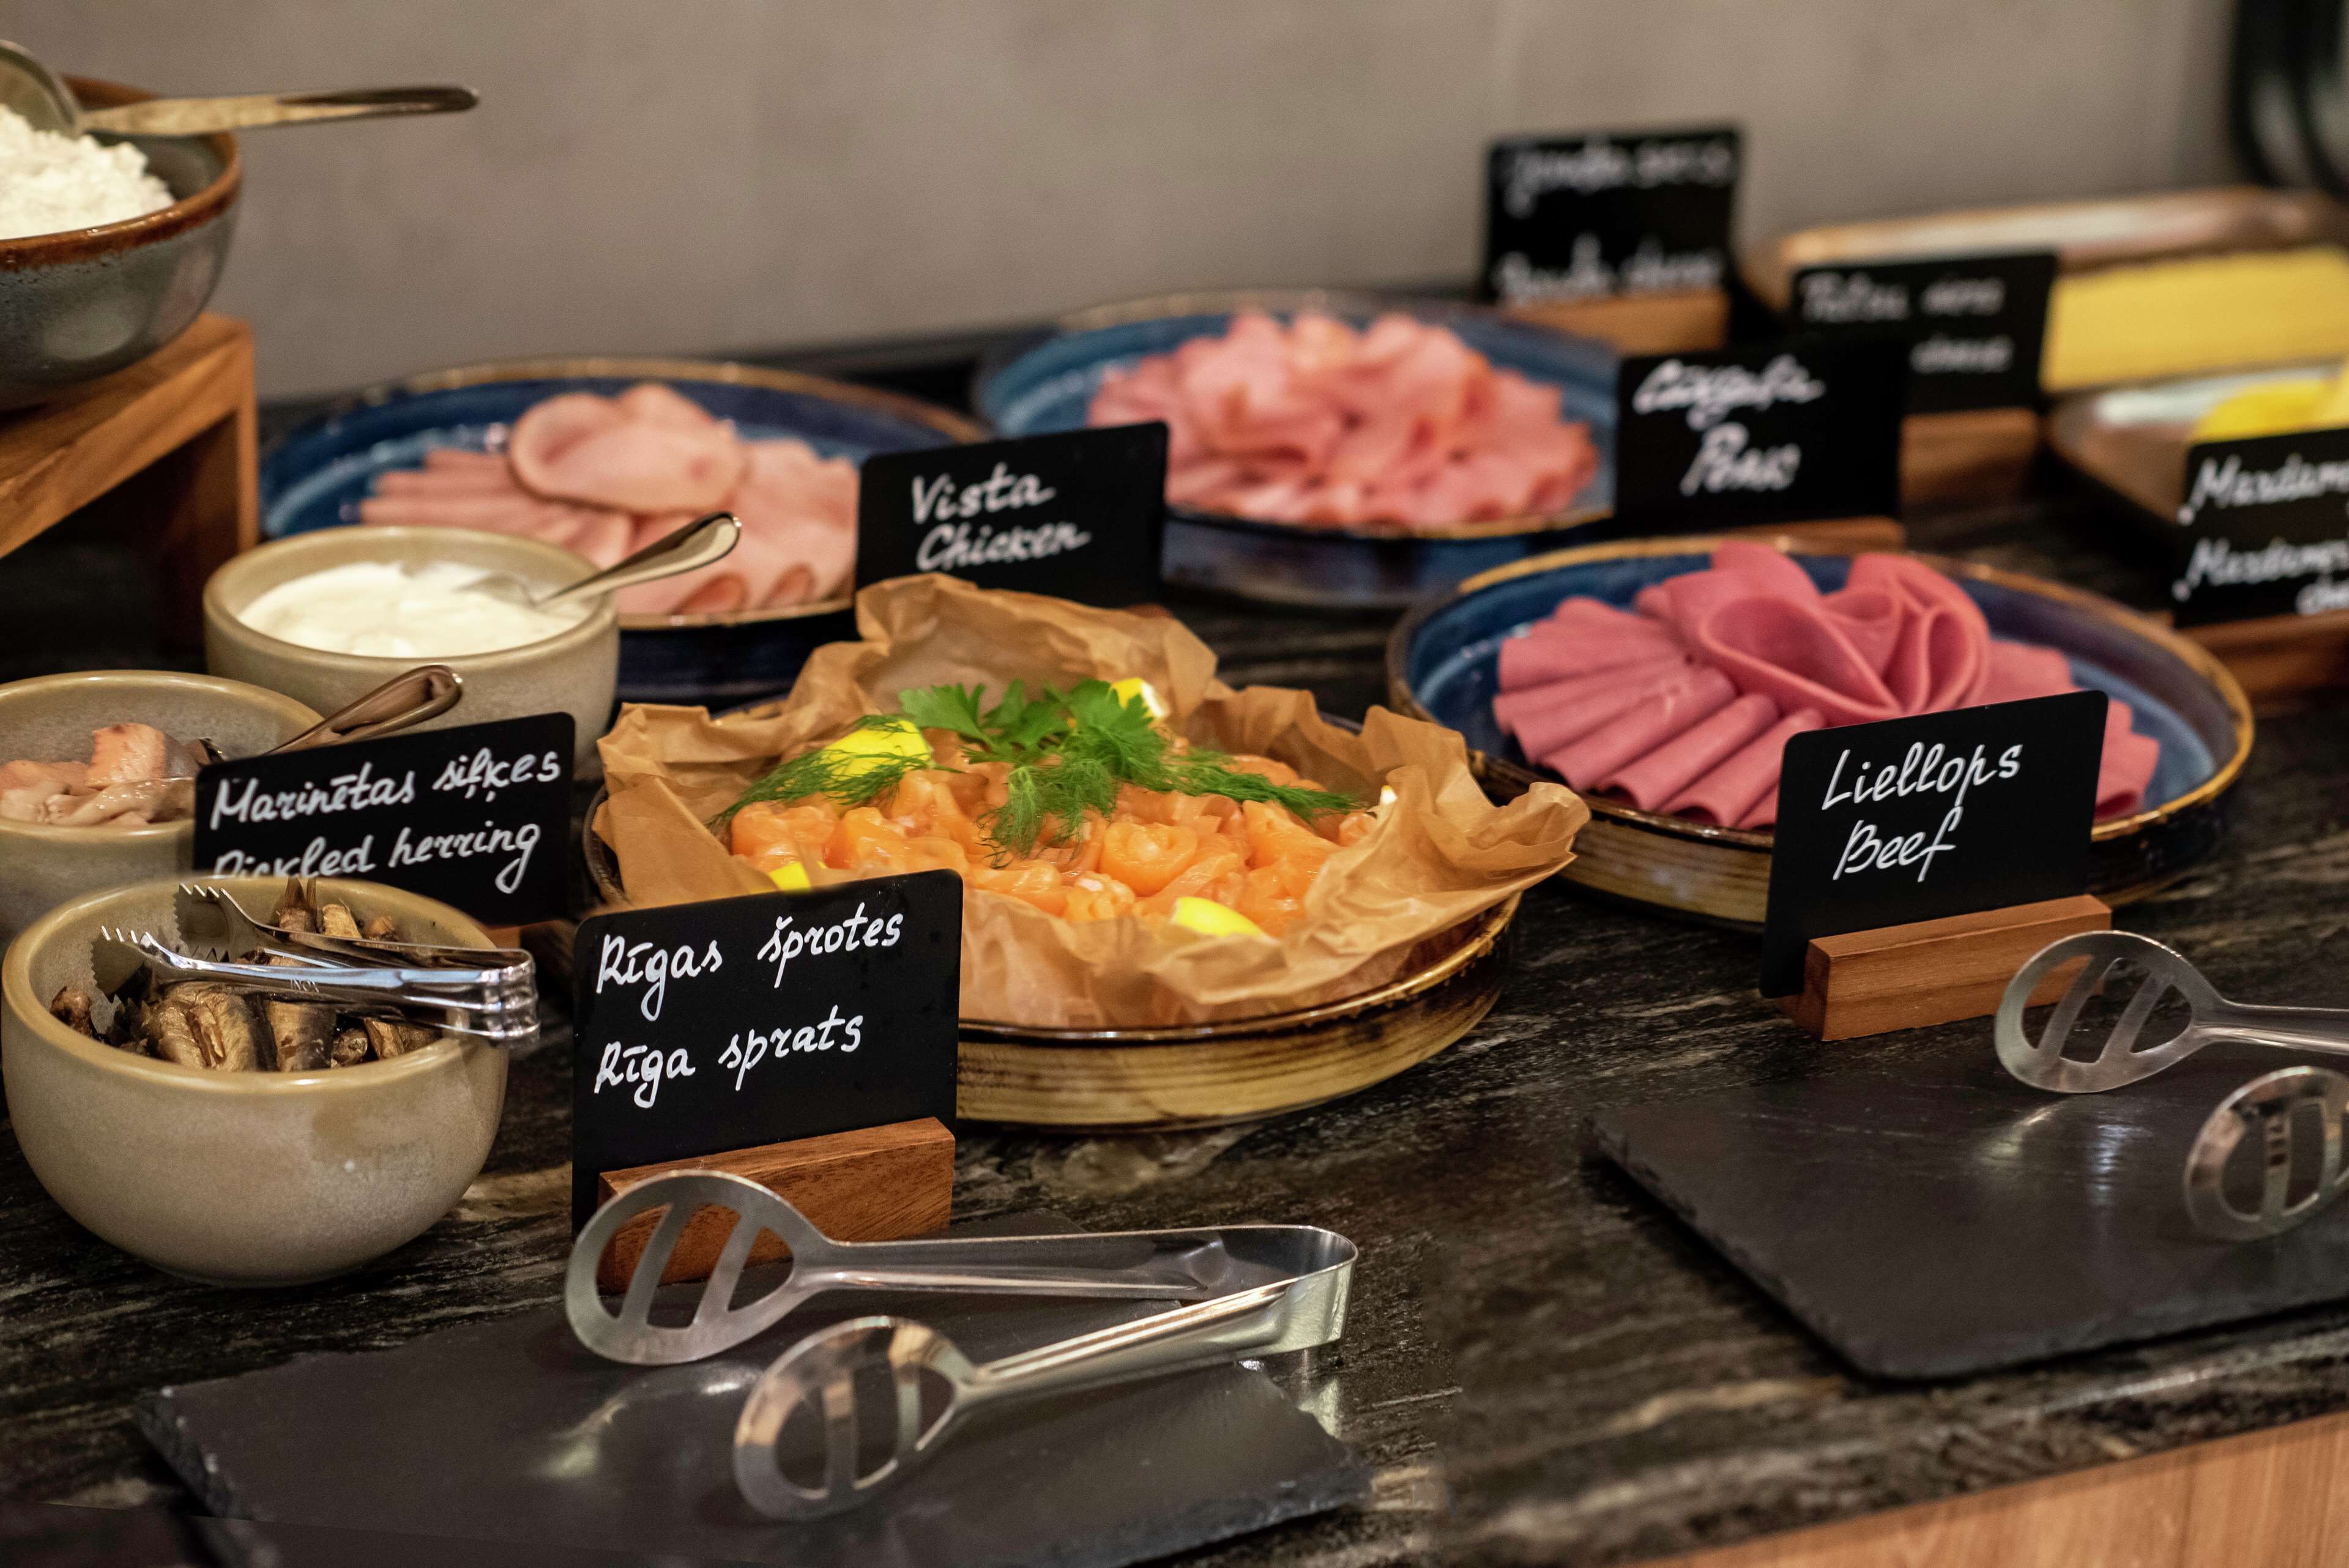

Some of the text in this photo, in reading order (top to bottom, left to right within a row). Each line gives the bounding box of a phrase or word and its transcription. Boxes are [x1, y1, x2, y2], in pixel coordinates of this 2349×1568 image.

[911, 461, 1057, 524] Vista
[916, 522, 1092, 571] Chicken
[210, 762, 415, 831] Marinētas
[1821, 741, 2023, 810] Liellops
[388, 820, 540, 894] herring
[1832, 805, 1964, 883] Beef
[595, 902, 904, 1022] Rīgas šprotes
[594, 1005, 864, 1109] Rīga sprats
